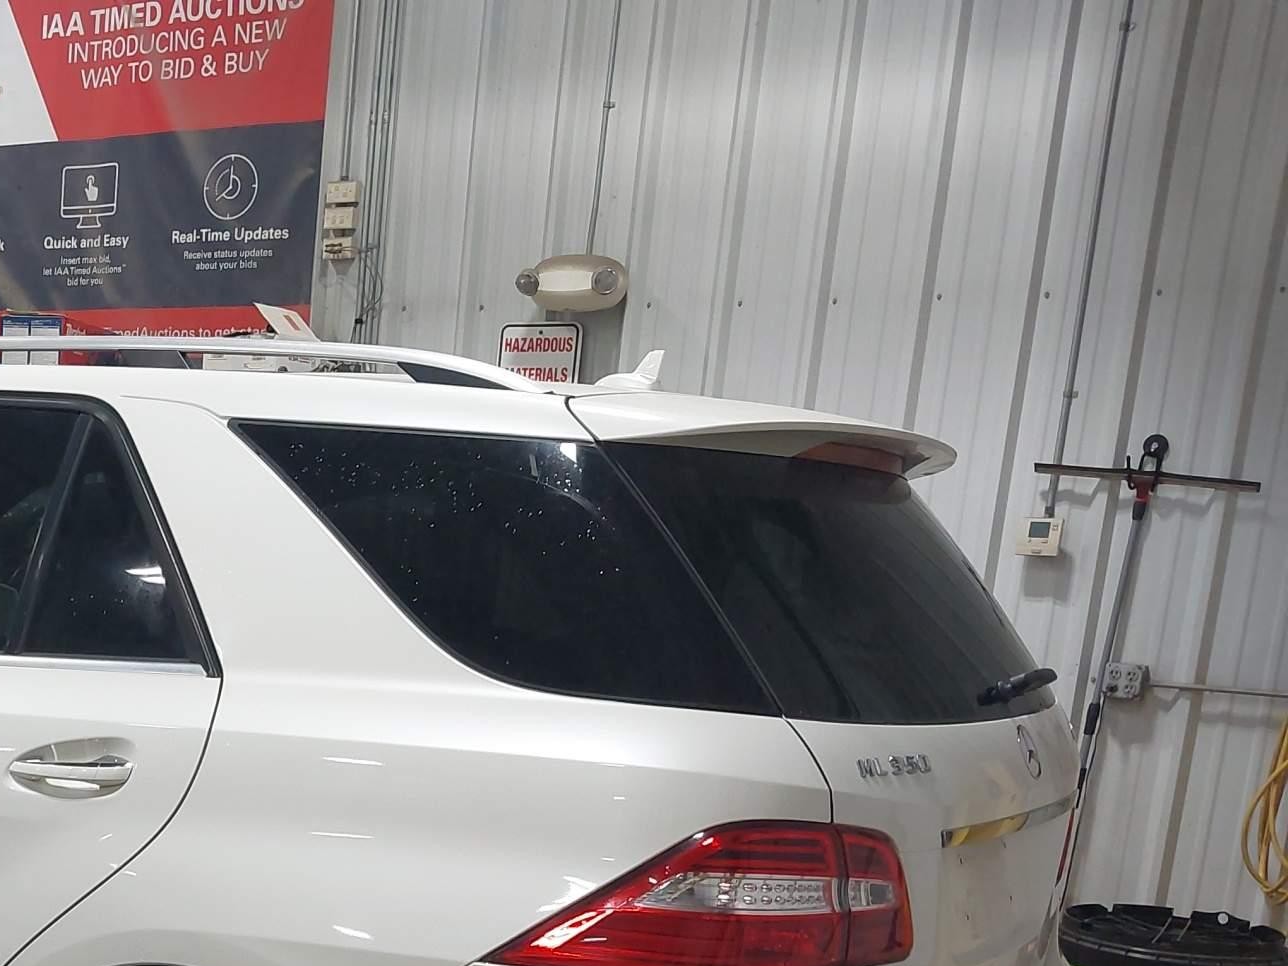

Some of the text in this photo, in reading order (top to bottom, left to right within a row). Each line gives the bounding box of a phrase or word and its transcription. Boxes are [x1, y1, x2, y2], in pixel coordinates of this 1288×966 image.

[42, 11, 84, 39] IAA
[90, 1, 162, 34] TIMED
[67, 18, 287, 63] INTRODUCING A NEW
[81, 49, 269, 89] WAY TO BID & BUY
[43, 234, 129, 249] Quick and Easy
[171, 227, 289, 244] Real-Time Updates
[60, 255, 80, 264] Insert
[81, 256, 97, 264] max
[183, 248, 272, 260] Receive status updates
[54, 266, 69, 275] IAA
[69, 265, 91, 275] Timed
[195, 260, 257, 271] about your bids
[66, 276, 103, 286] bid for you
[504, 336, 573, 352] HAZARDOUS
[856, 754, 931, 778] ML 350
